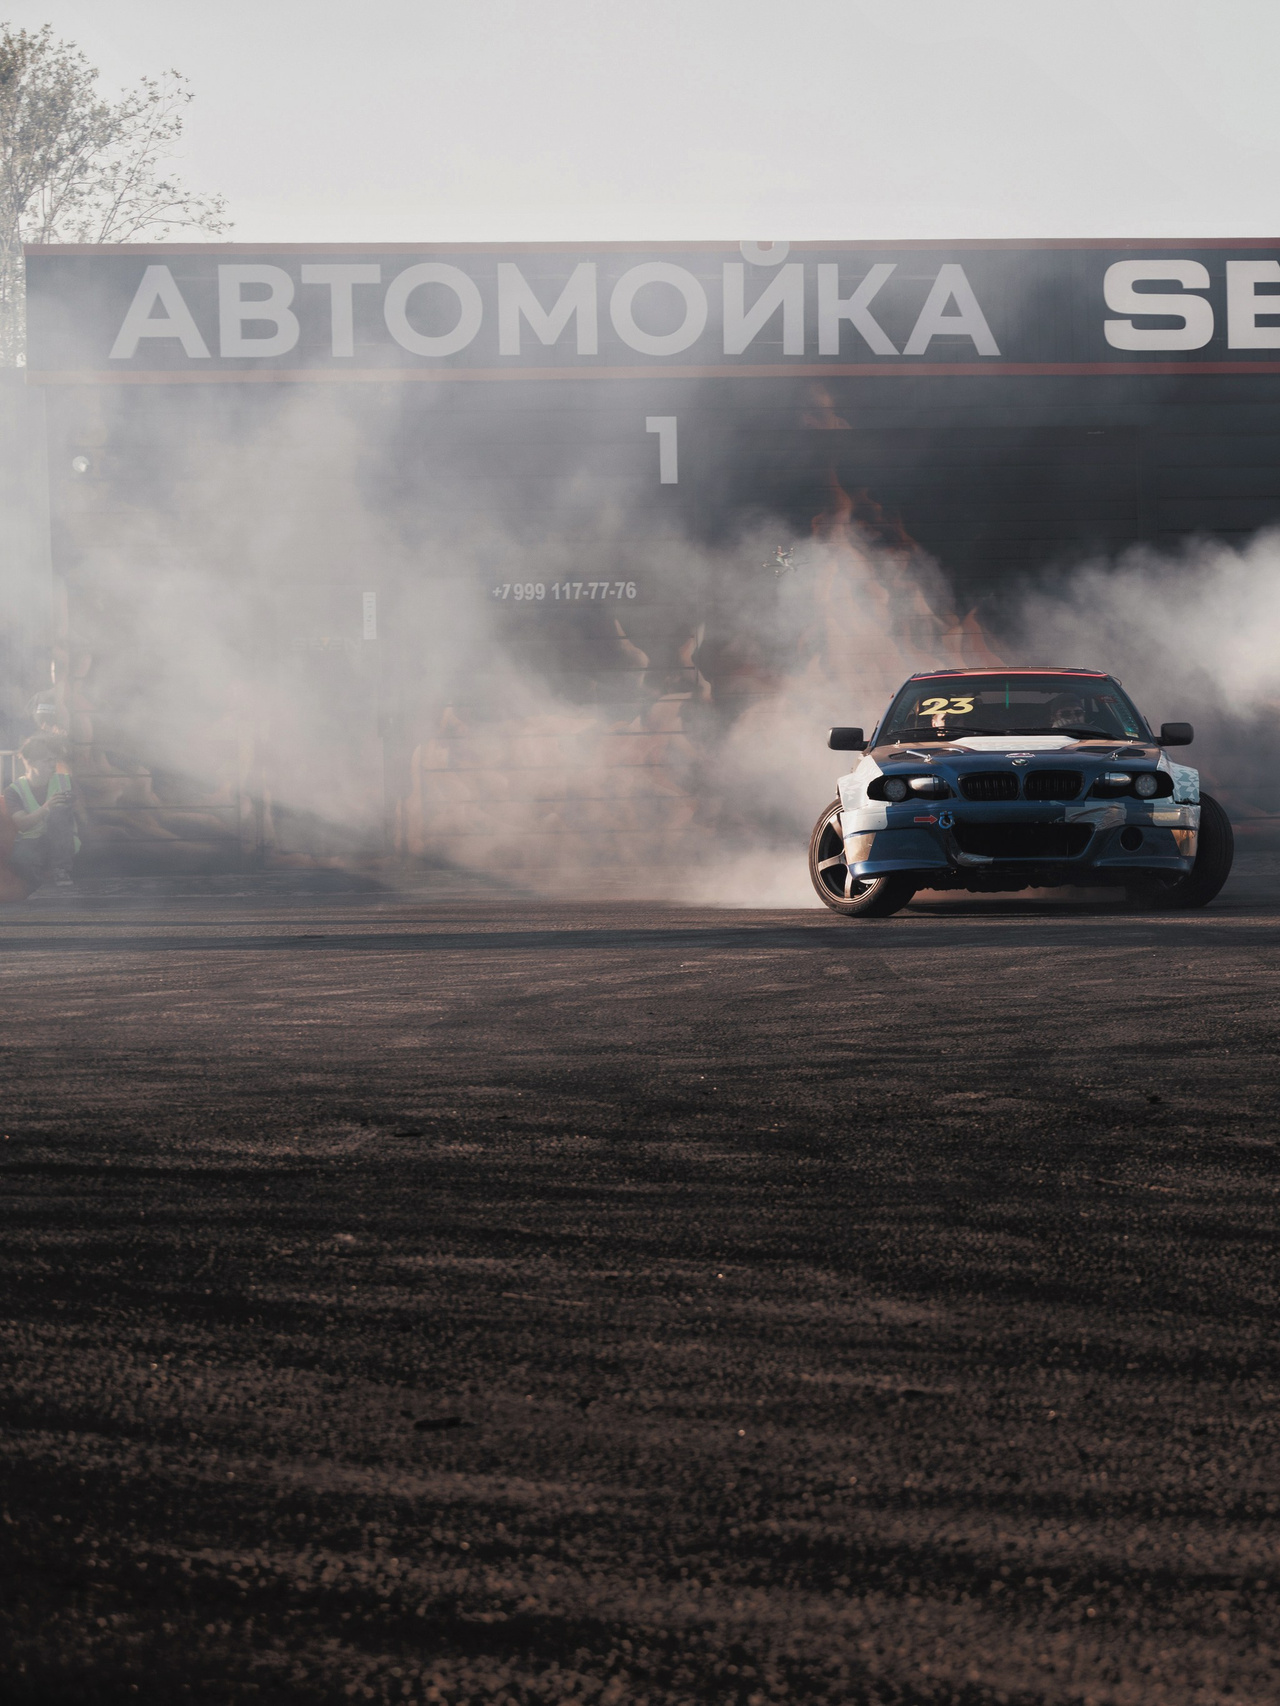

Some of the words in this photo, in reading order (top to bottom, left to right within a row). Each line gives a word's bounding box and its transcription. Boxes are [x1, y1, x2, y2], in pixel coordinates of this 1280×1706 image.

[109, 241, 1001, 360] АВТОМОЙКА
[646, 416, 678, 484] 1
[513, 582, 546, 600] 999
[551, 581, 638, 600] 117-77-76
[919, 697, 975, 716] 23
